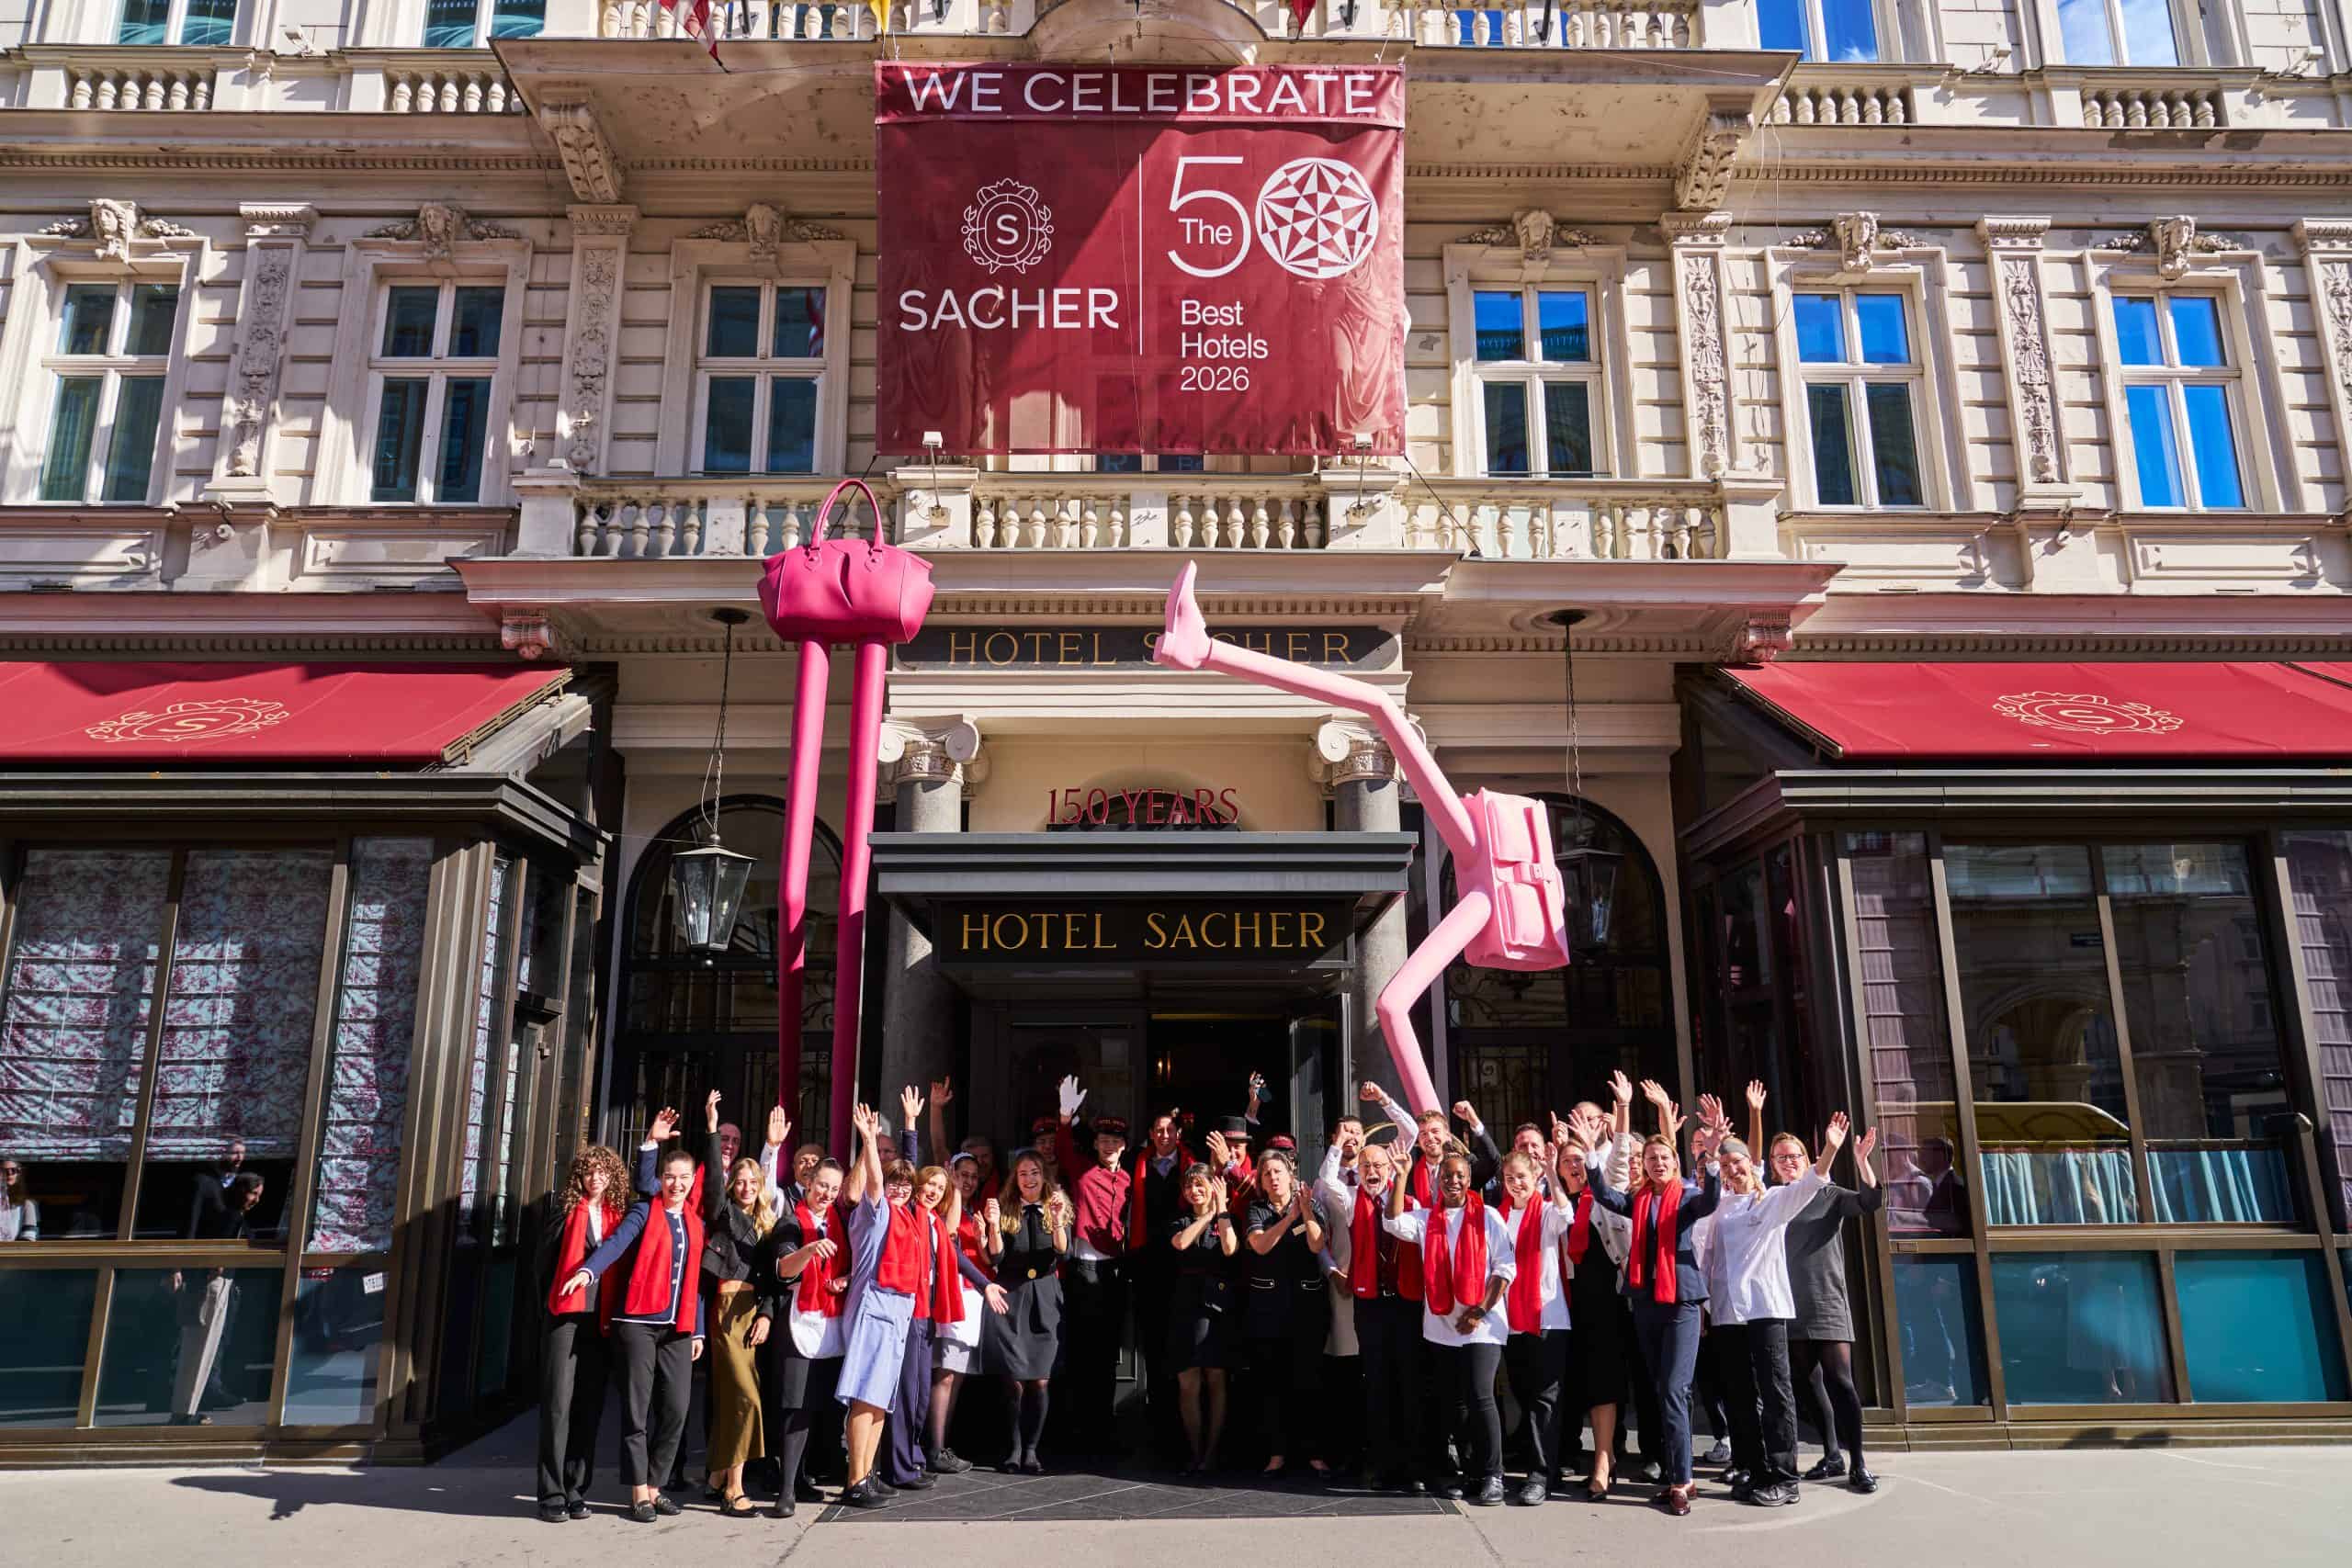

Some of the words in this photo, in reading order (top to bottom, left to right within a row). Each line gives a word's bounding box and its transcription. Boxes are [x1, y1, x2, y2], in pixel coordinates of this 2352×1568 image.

[902, 71, 1003, 112] WE
[1023, 72, 1377, 115] CELEBRATE
[1179, 218, 1233, 245] The
[899, 287, 1120, 332] SACHER
[1182, 299, 1244, 327] Best
[1182, 332, 1269, 359] Hotels
[1181, 366, 1250, 392] 2026
[949, 632, 1117, 666] HOTEL
[1047, 787, 1110, 824] 150
[1121, 787, 1239, 824] YEARS
[962, 912, 1117, 950] HOTEL
[1144, 911, 1327, 949] SACHER
